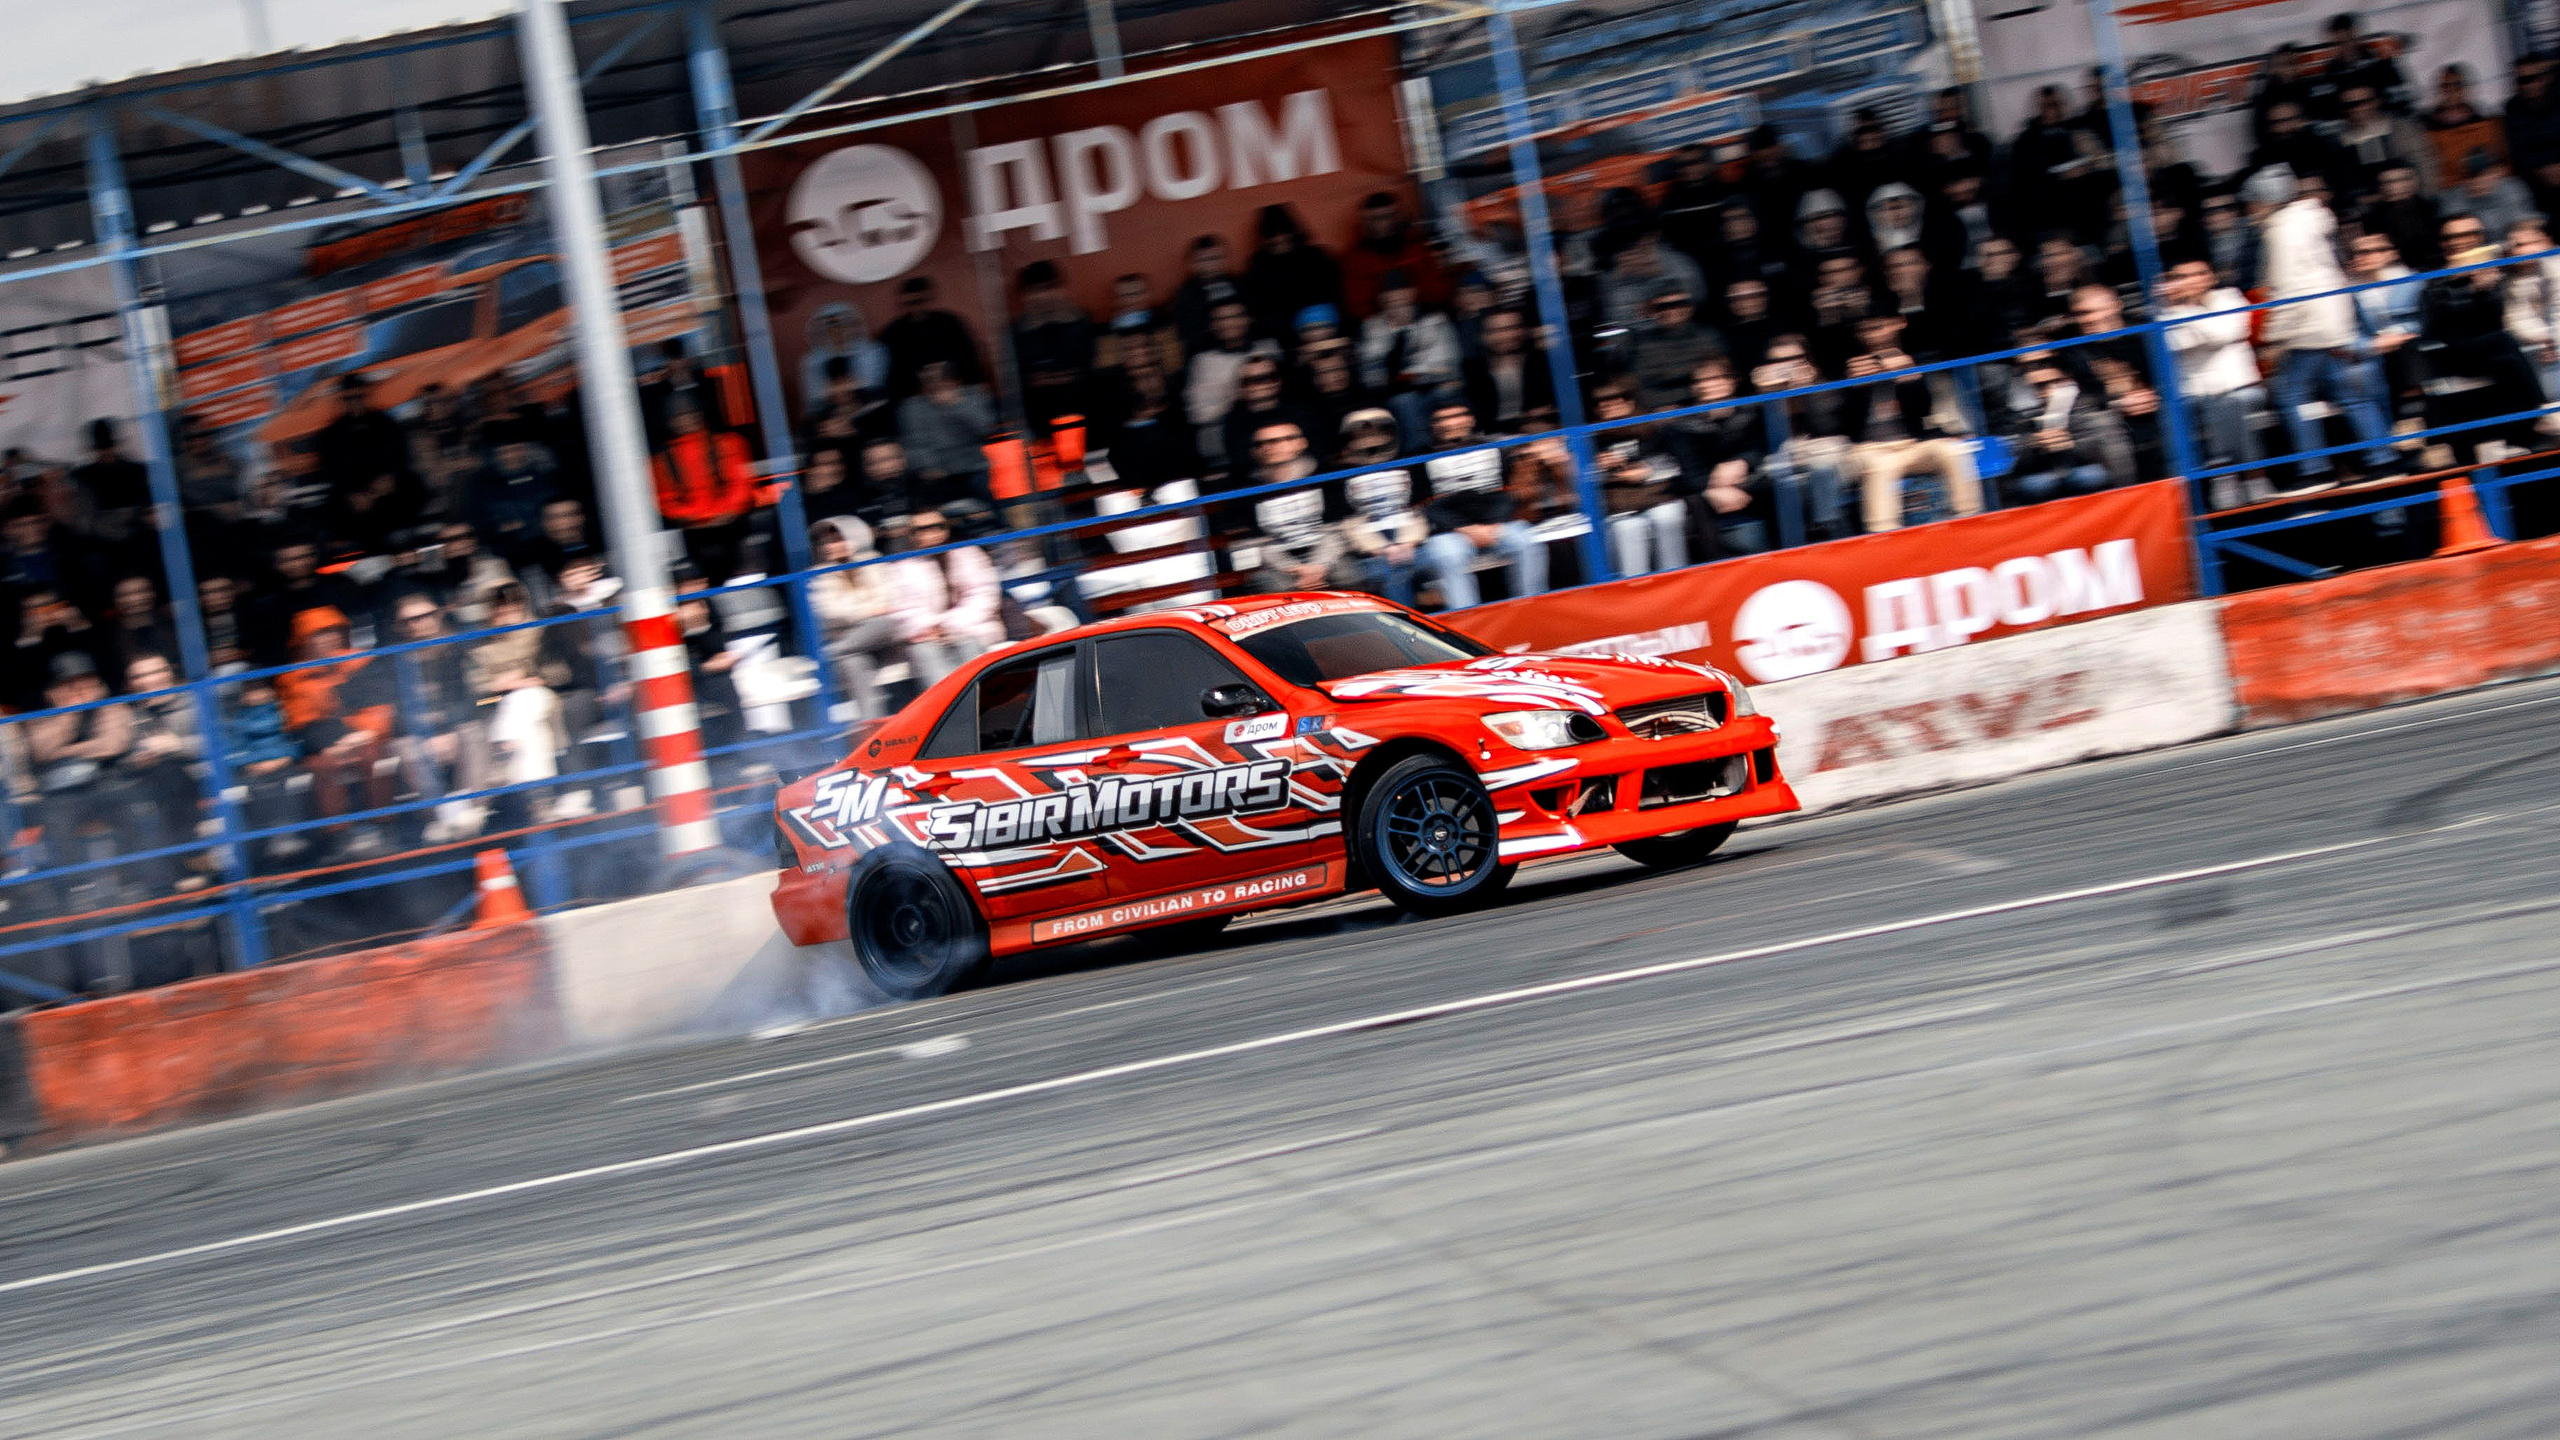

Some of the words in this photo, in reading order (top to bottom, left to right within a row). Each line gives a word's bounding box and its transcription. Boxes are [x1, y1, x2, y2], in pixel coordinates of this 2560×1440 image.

[1226, 611, 1279, 631] DRIFT
[1052, 914, 1103, 935] FROM
[1112, 895, 1193, 922] CIVILIAN
[1202, 890, 1226, 905] TO
[1234, 873, 1307, 899] RACING
